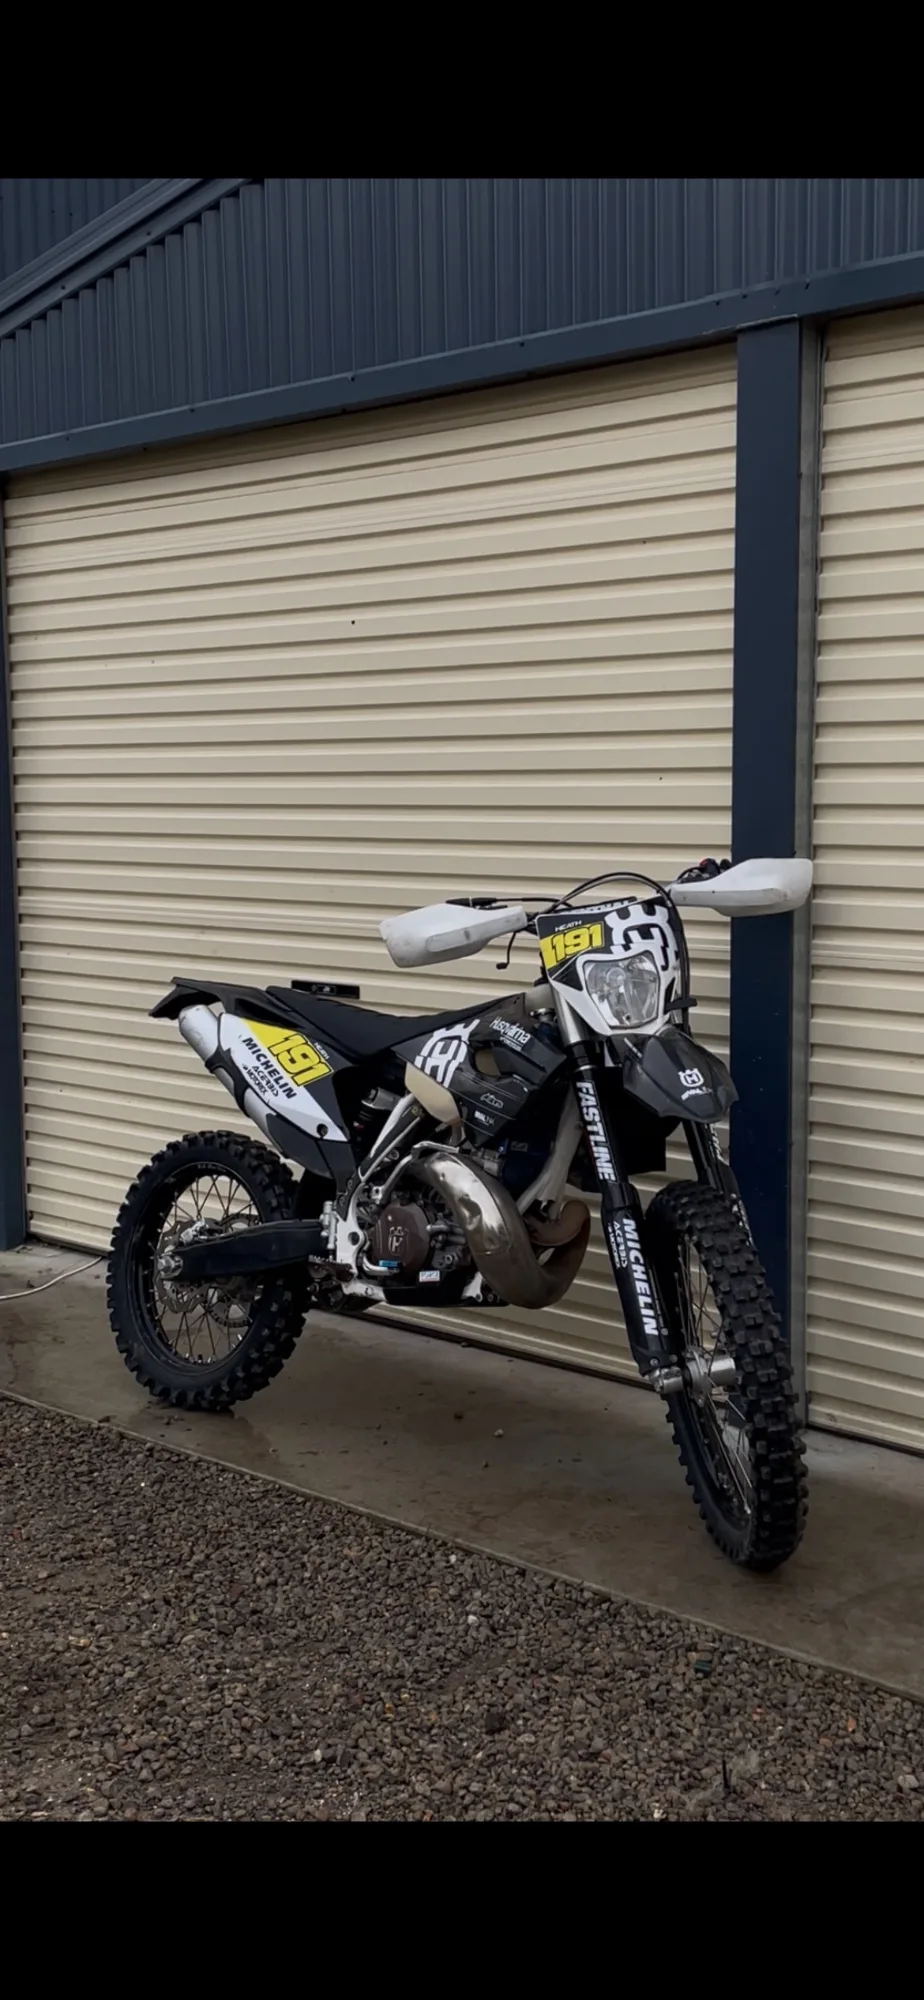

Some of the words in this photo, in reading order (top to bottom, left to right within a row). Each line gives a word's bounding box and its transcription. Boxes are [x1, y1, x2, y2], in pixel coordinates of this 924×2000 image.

[551, 922, 603, 962] 191
[555, 920, 582, 932] HEATH
[242, 1037, 297, 1099] MICHELIN
[267, 1033, 332, 1087] 191
[576, 1082, 616, 1181] FASTLINE
[622, 1218, 659, 1336] MICHELIN
